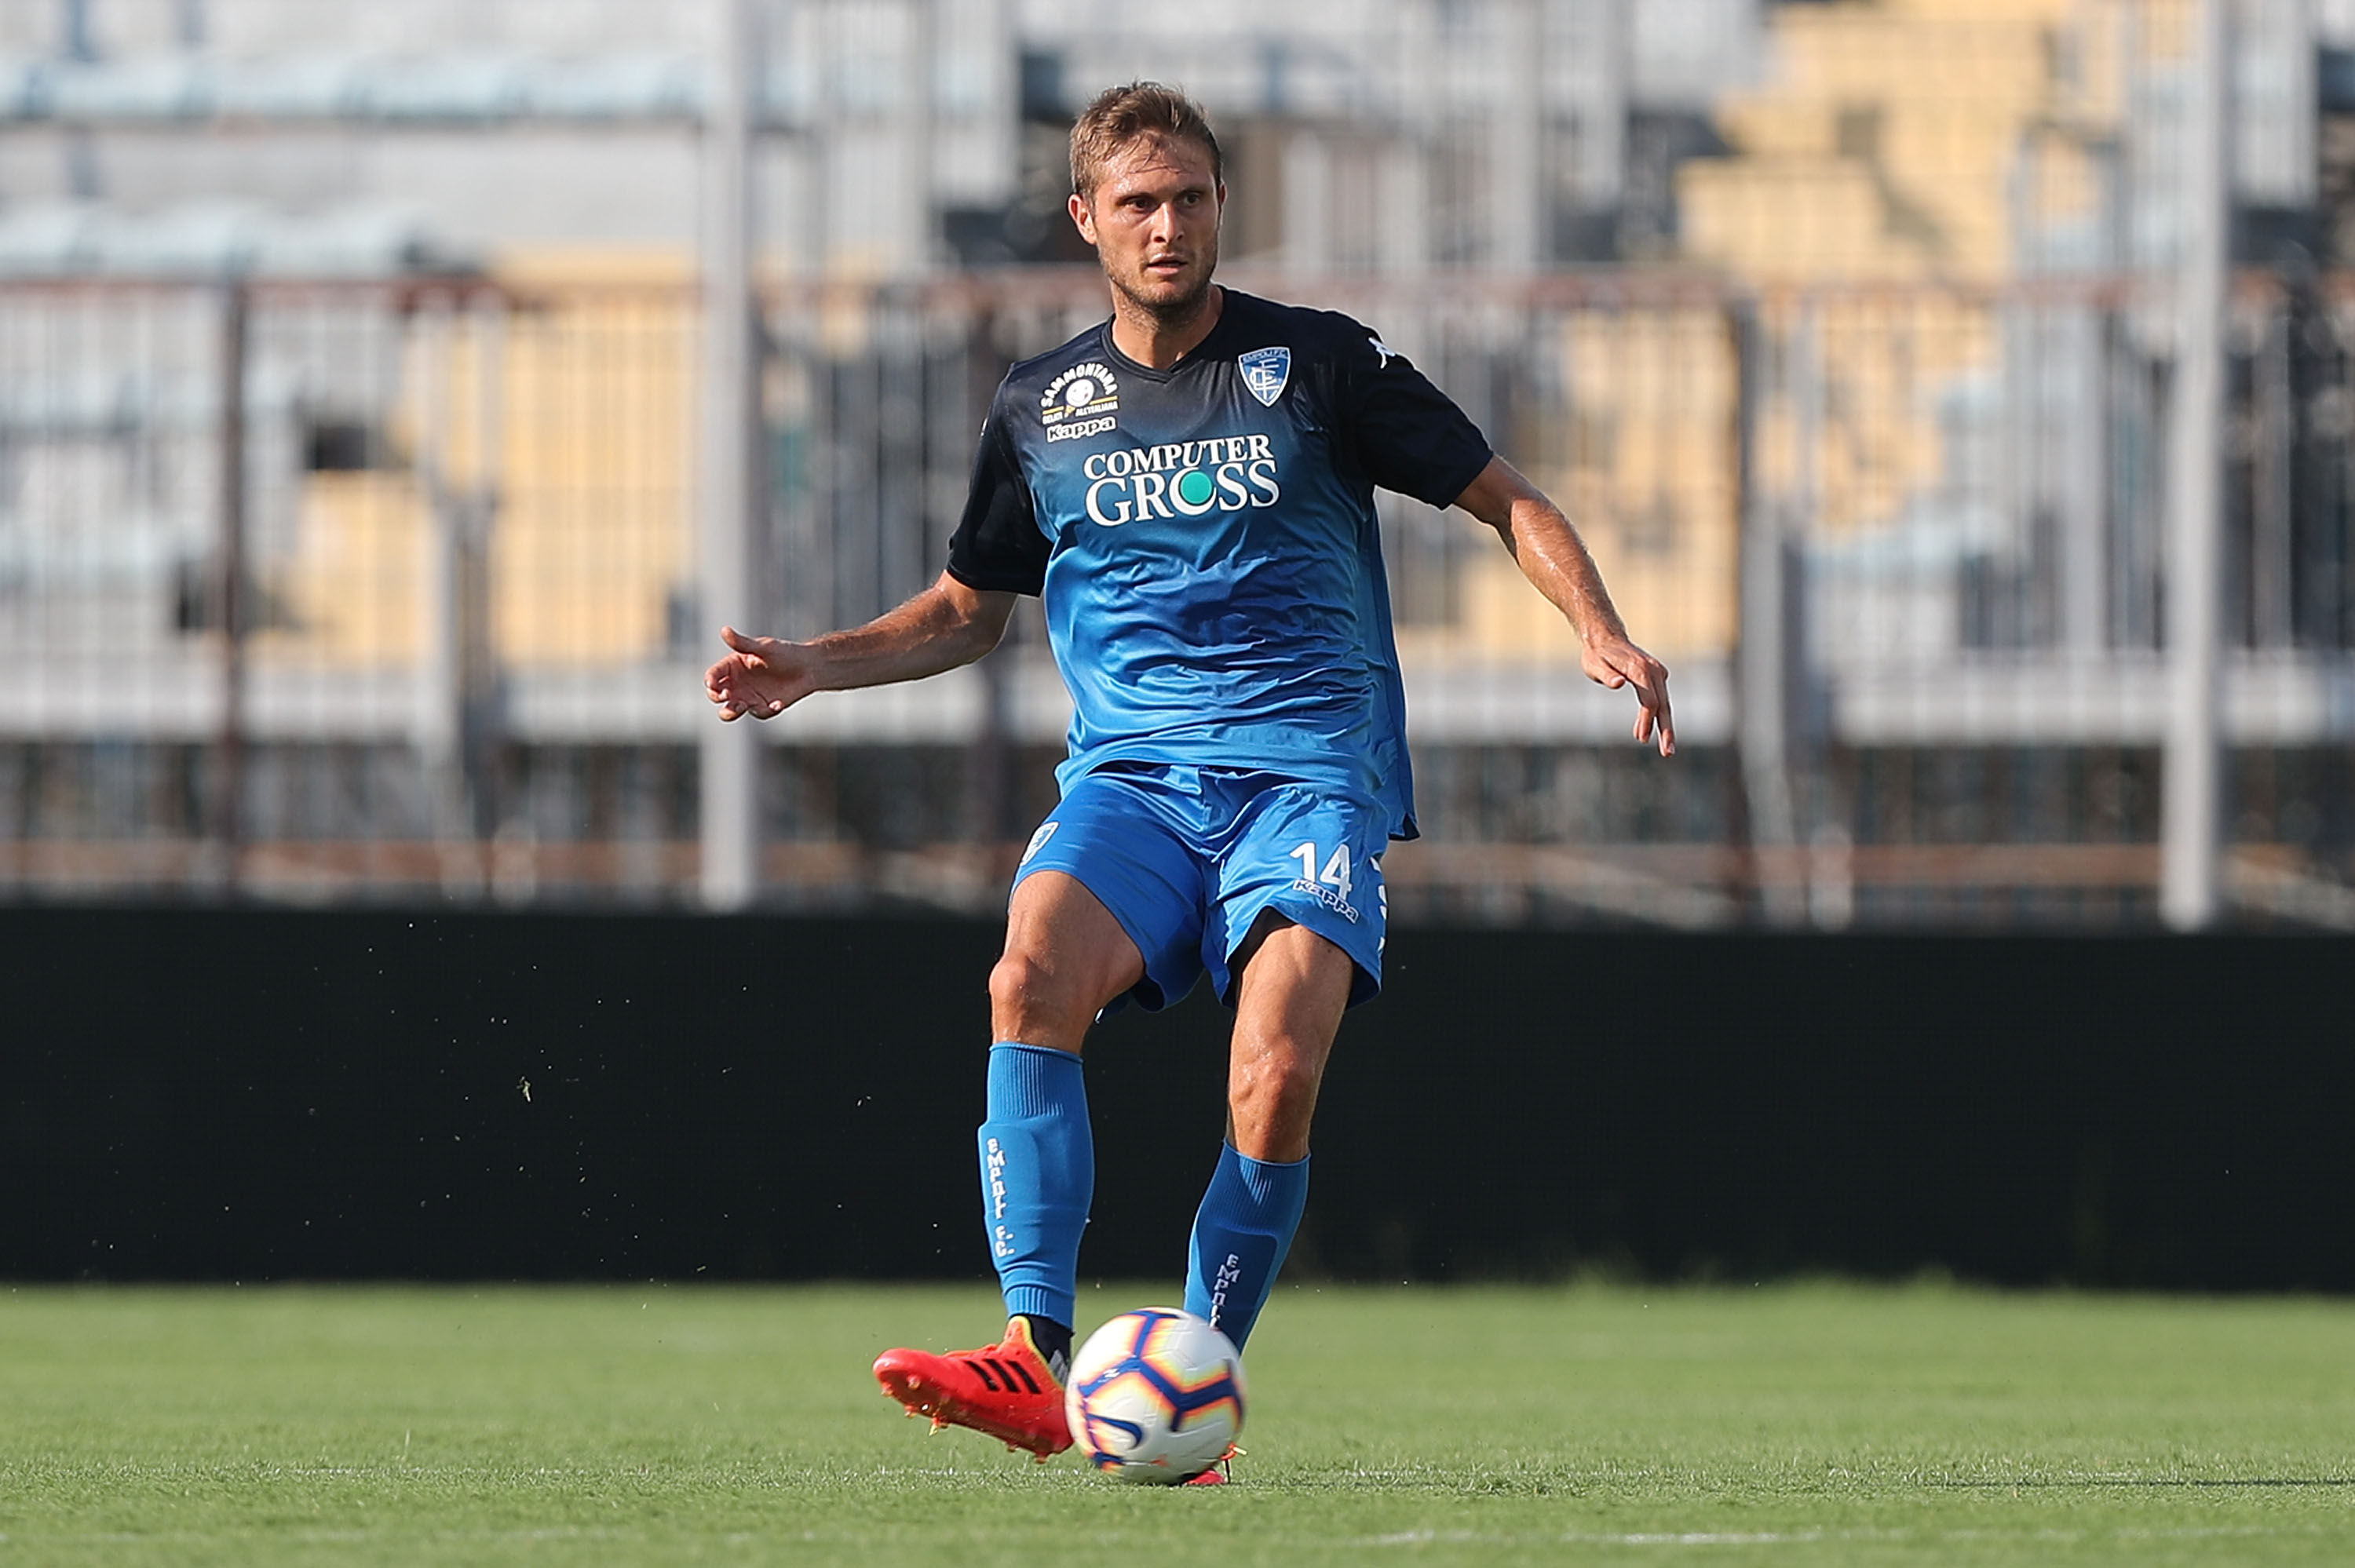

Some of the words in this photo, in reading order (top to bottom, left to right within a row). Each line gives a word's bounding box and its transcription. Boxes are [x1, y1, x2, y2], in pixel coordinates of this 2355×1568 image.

[1040, 362, 1119, 407] SAMMONTANA
[1047, 417, 1115, 443] Kappa
[1083, 434, 1274, 480] COMPUTER
[1085, 459, 1280, 527] GROSS
[1289, 841, 1353, 901] 14
[1293, 878, 1360, 924] Kappa
